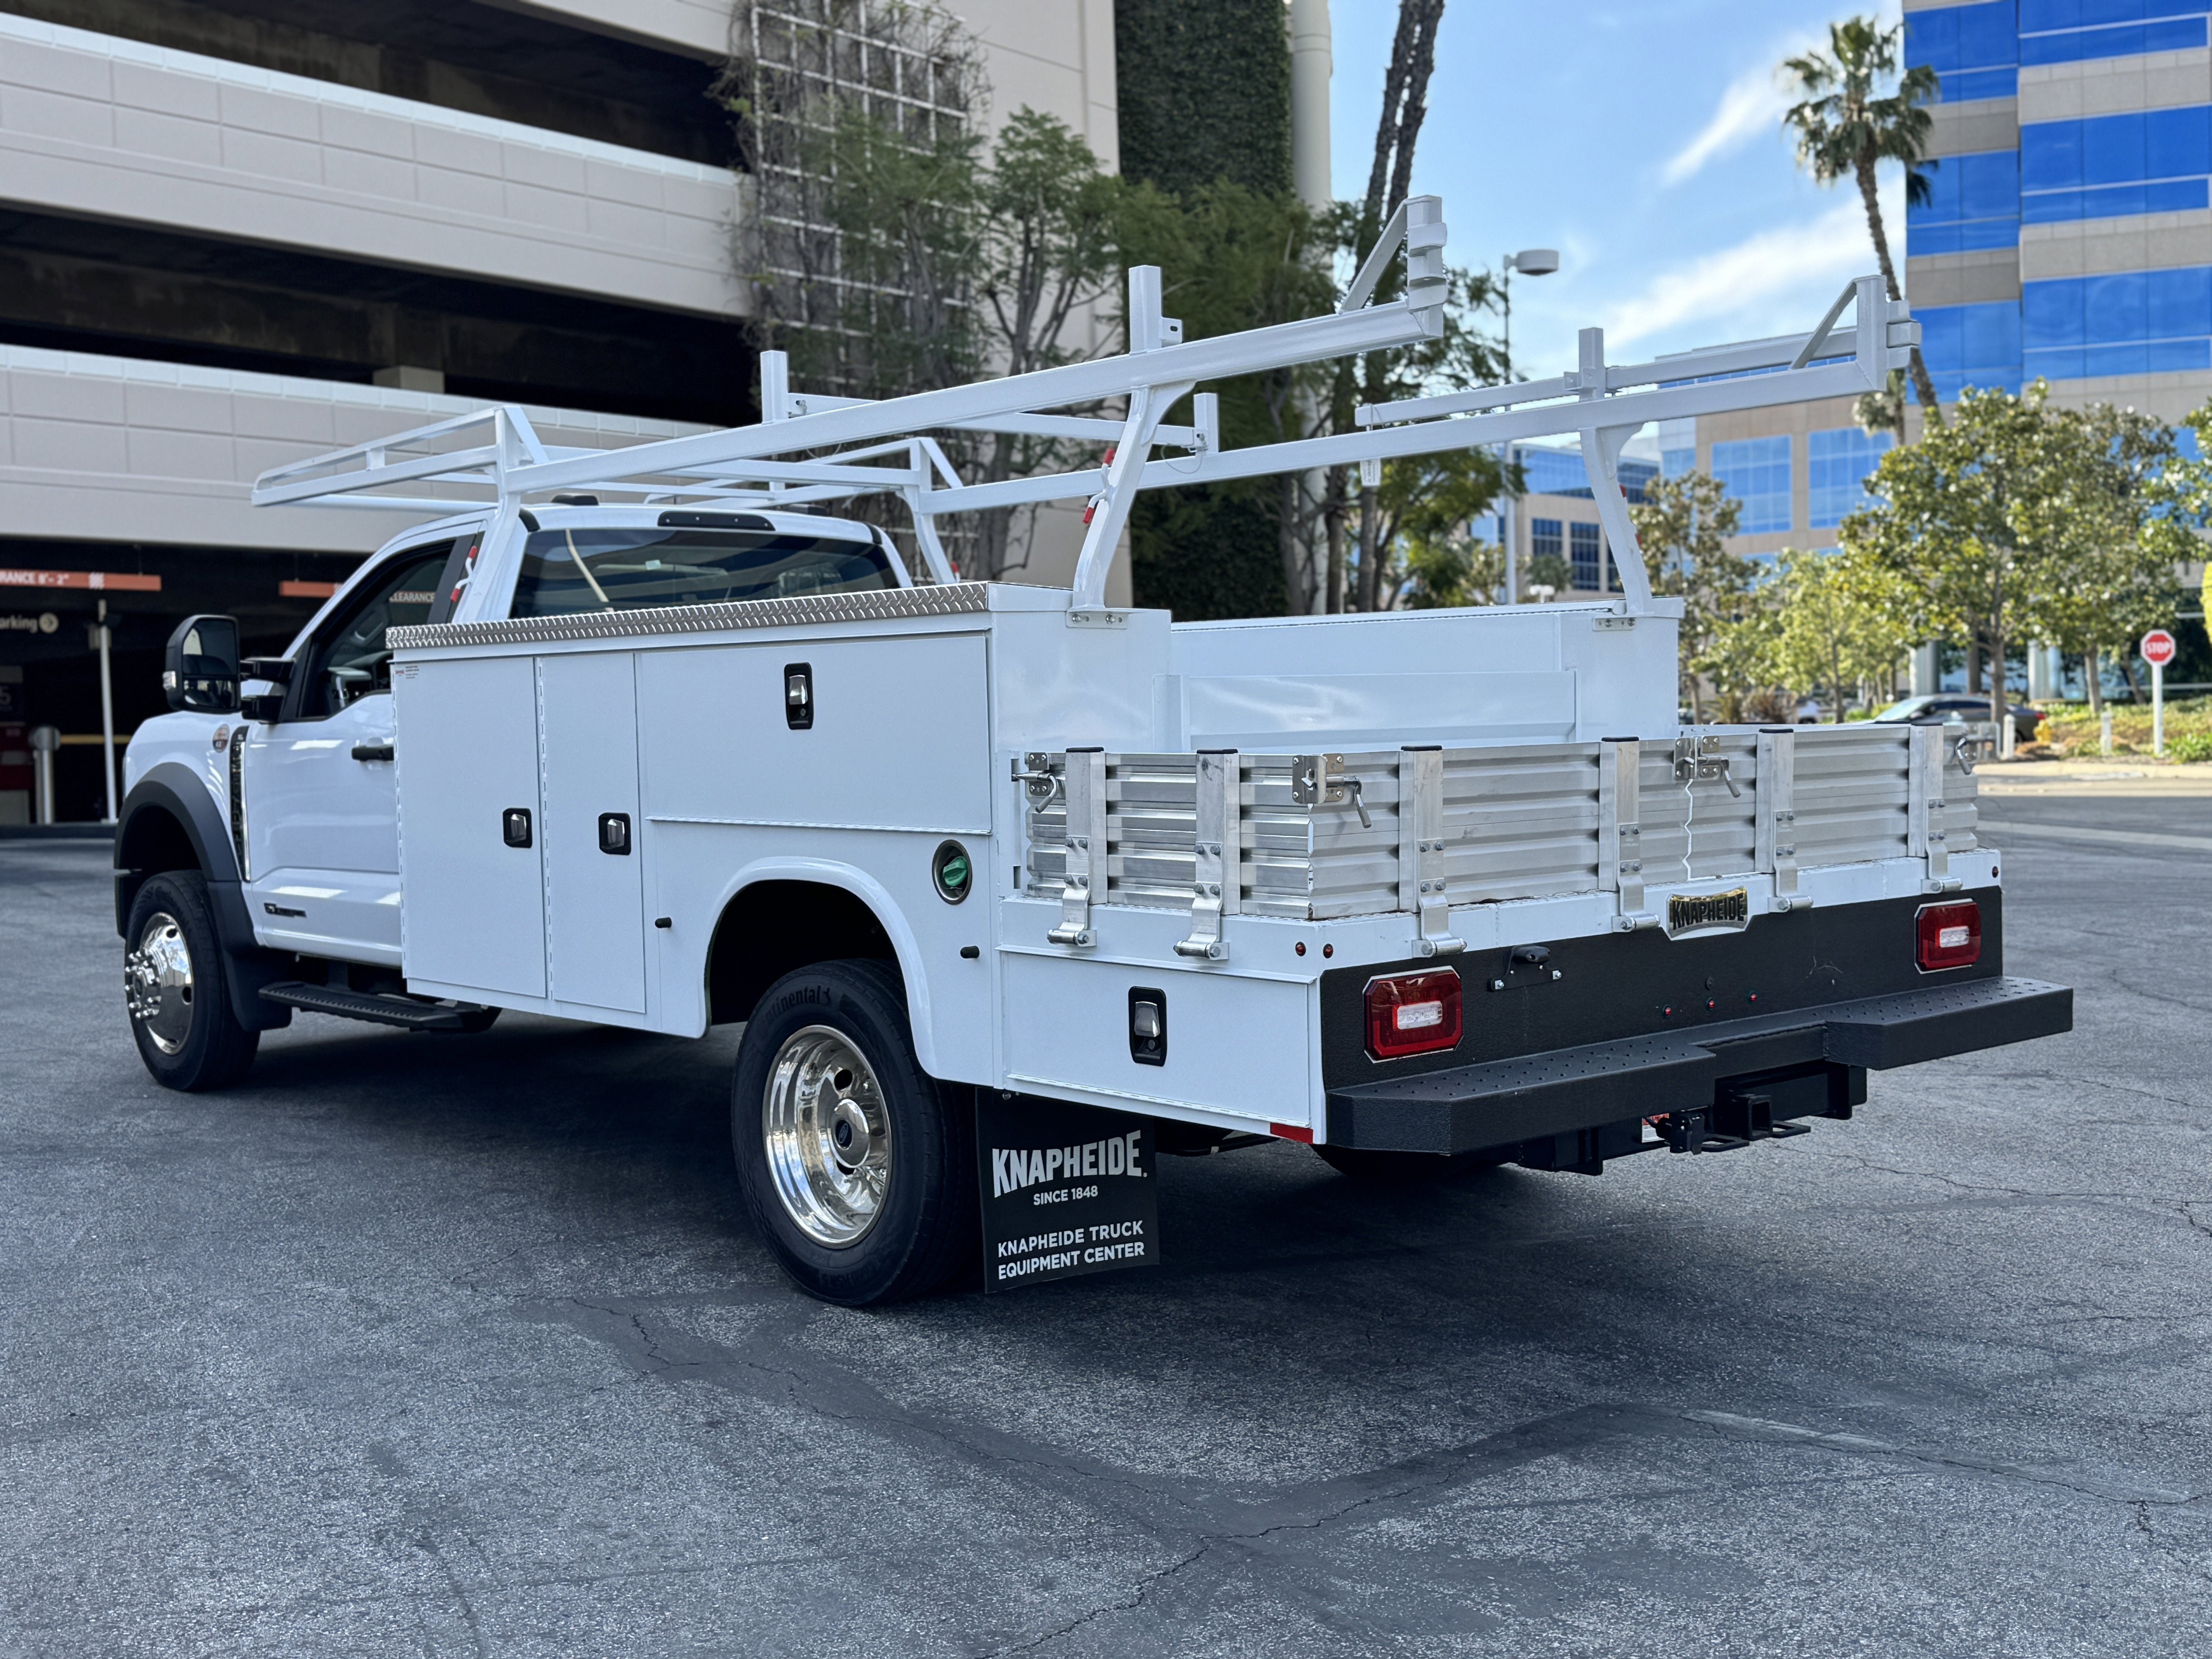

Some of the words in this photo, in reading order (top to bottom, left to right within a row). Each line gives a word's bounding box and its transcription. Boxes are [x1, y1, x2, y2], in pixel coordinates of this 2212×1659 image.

[2145, 641, 2171, 655] STOP
[1672, 892, 1744, 931] KNAPHEIDE
[1033, 1189, 1068, 1206] SINCE
[1071, 1185, 1098, 1200] 1848
[998, 1228, 1084, 1257] KNAPHEIDE
[1089, 1220, 1144, 1241] TRUCK
[998, 1251, 1080, 1280] EQUIPMENT
[1085, 1242, 1145, 1263] CENTER
